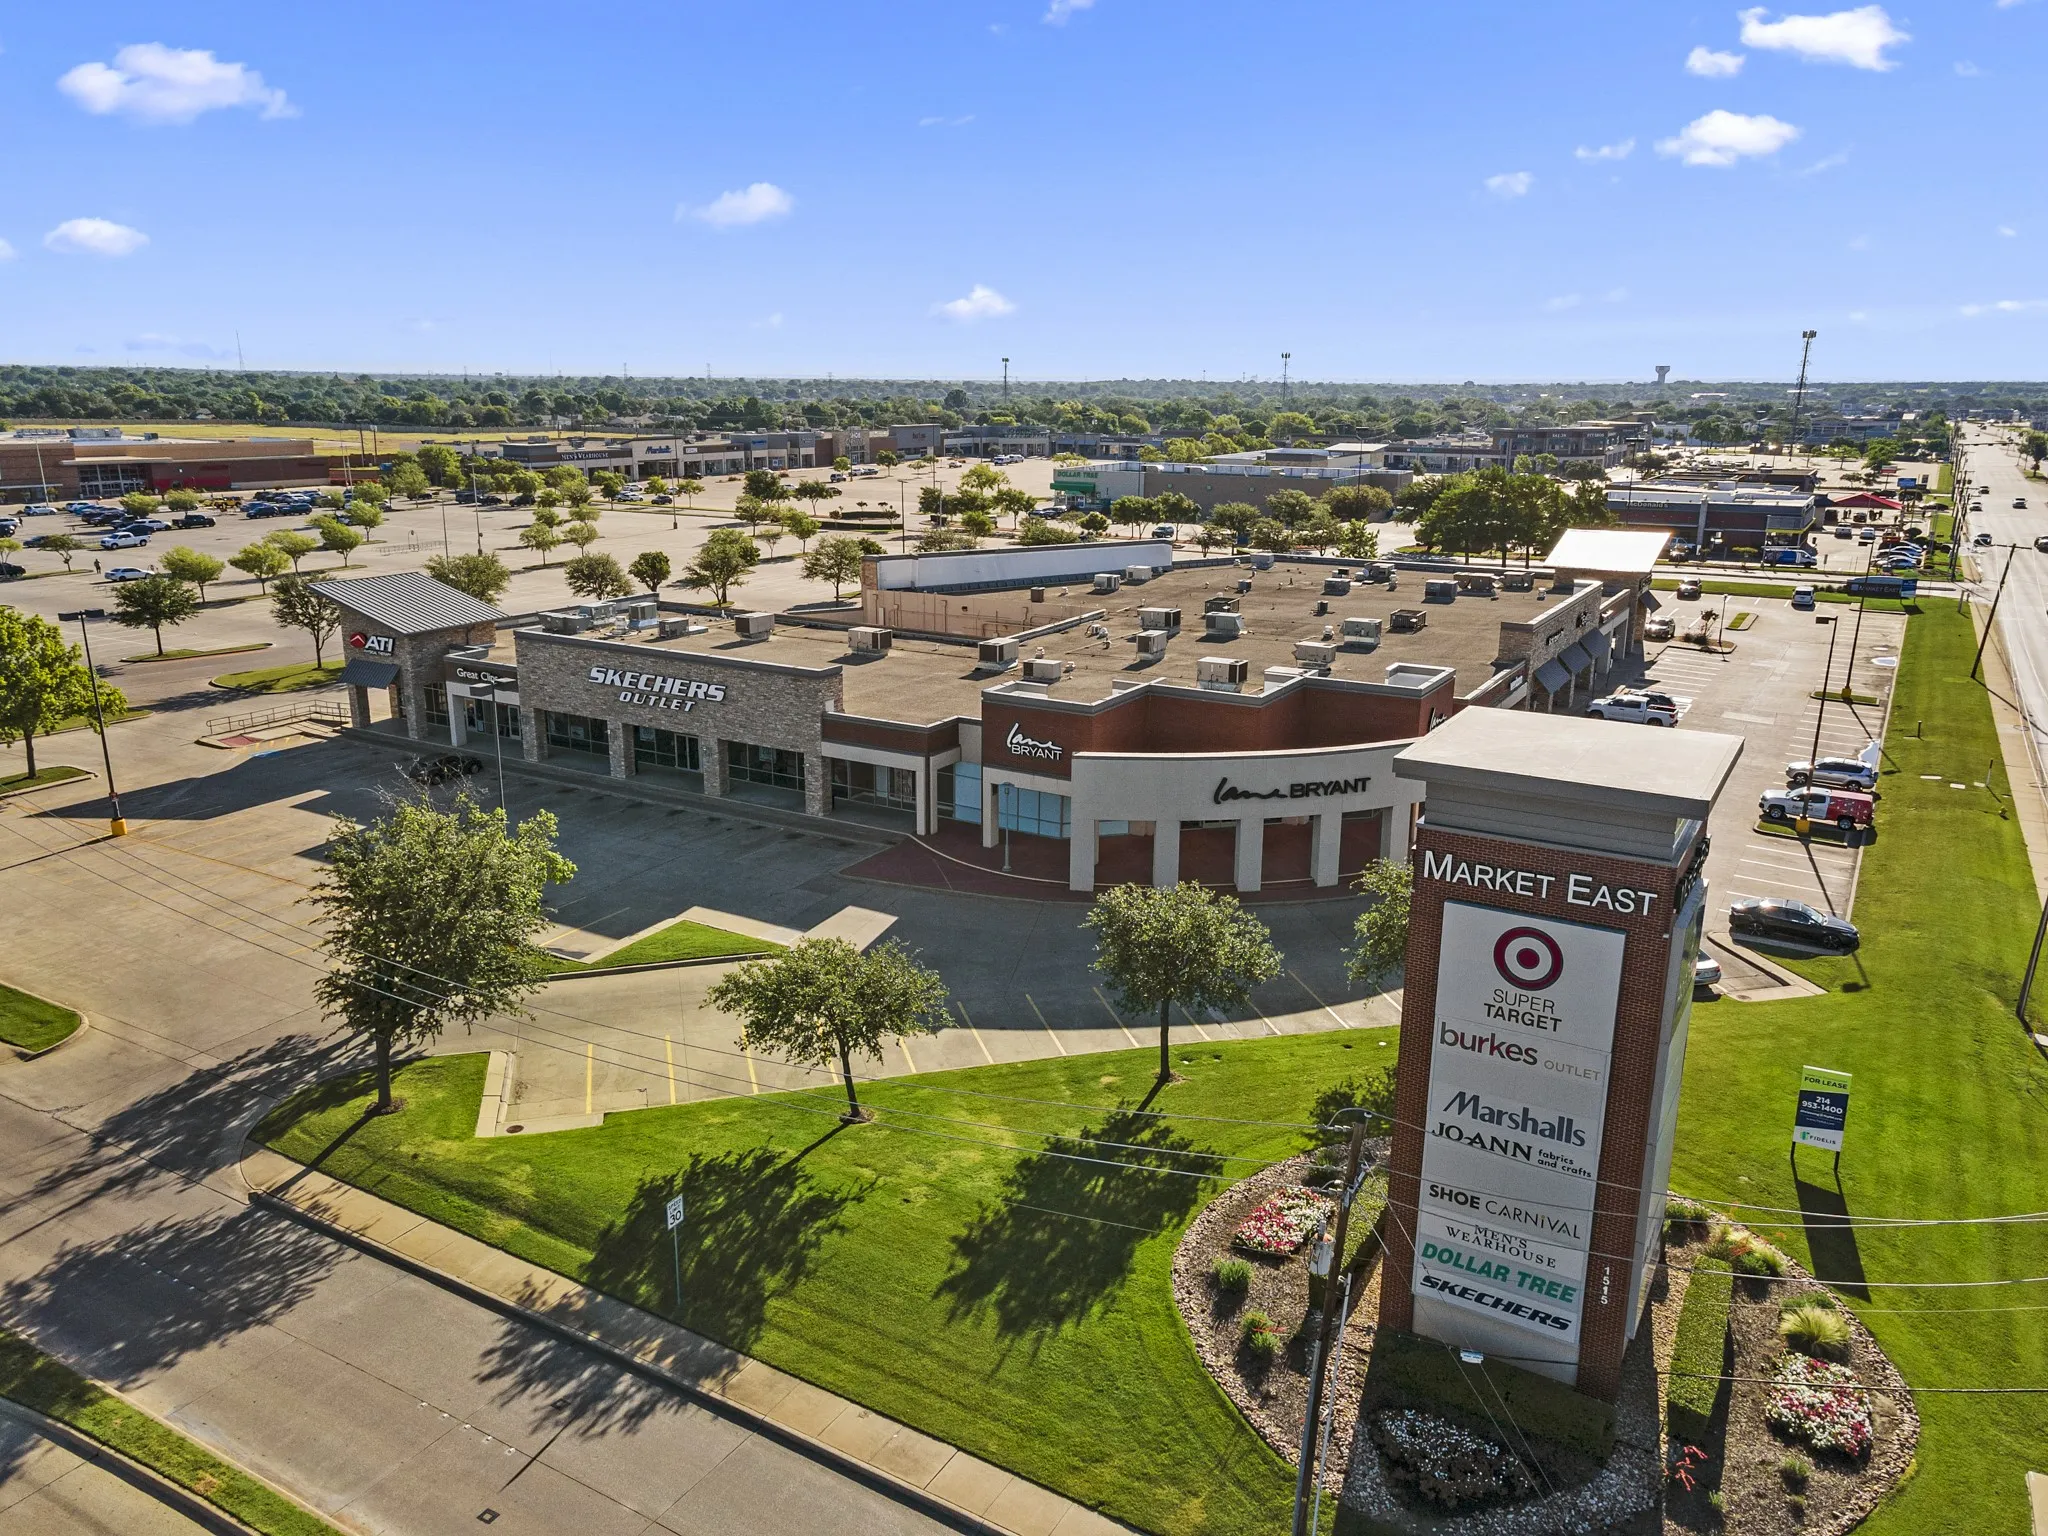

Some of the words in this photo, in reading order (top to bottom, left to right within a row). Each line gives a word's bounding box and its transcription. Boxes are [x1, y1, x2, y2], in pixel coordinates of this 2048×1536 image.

[1057, 470, 1081, 478] DOLLAR
[364, 635, 394, 652] ATI
[456, 667, 479, 680] Great
[588, 667, 727, 702] SKECHERS
[619, 691, 695, 712] OUTLET
[1010, 744, 1063, 761] BRYANT
[1288, 776, 1372, 799] BRYANT
[1423, 850, 1556, 899] MARKET
[1567, 873, 1658, 916] EAST
[1492, 988, 1555, 1014] SUPER
[1483, 1003, 1562, 1032] TARGET
[1440, 1021, 1538, 1066] burkes
[1544, 1059, 1601, 1081] OUTLET
[1804, 1076, 1821, 1085] FOR
[1822, 1079, 1848, 1090] LEASE
[1802, 1100, 1843, 1114] 953-1400
[1816, 1096, 1830, 1105] 214
[1443, 1091, 1586, 1147] Marshalls
[1809, 1135, 1836, 1145] FIDELIS
[1537, 1157, 1557, 1169] and
[1561, 1164, 1592, 1178] crafts
[1538, 1148, 1574, 1165] fabrics
[1429, 1184, 1481, 1210] SHOE
[669, 1210, 682, 1225] 30
[1445, 1225, 1557, 1269] WEARHOUSE
[1474, 1224, 1528, 1249] MEN'S
[1421, 1242, 1511, 1282] DOLLAR
[1514, 1271, 1577, 1304] TREE
[1600, 1266, 1610, 1305] 1515
[1420, 1274, 1572, 1331] SKECHERS
